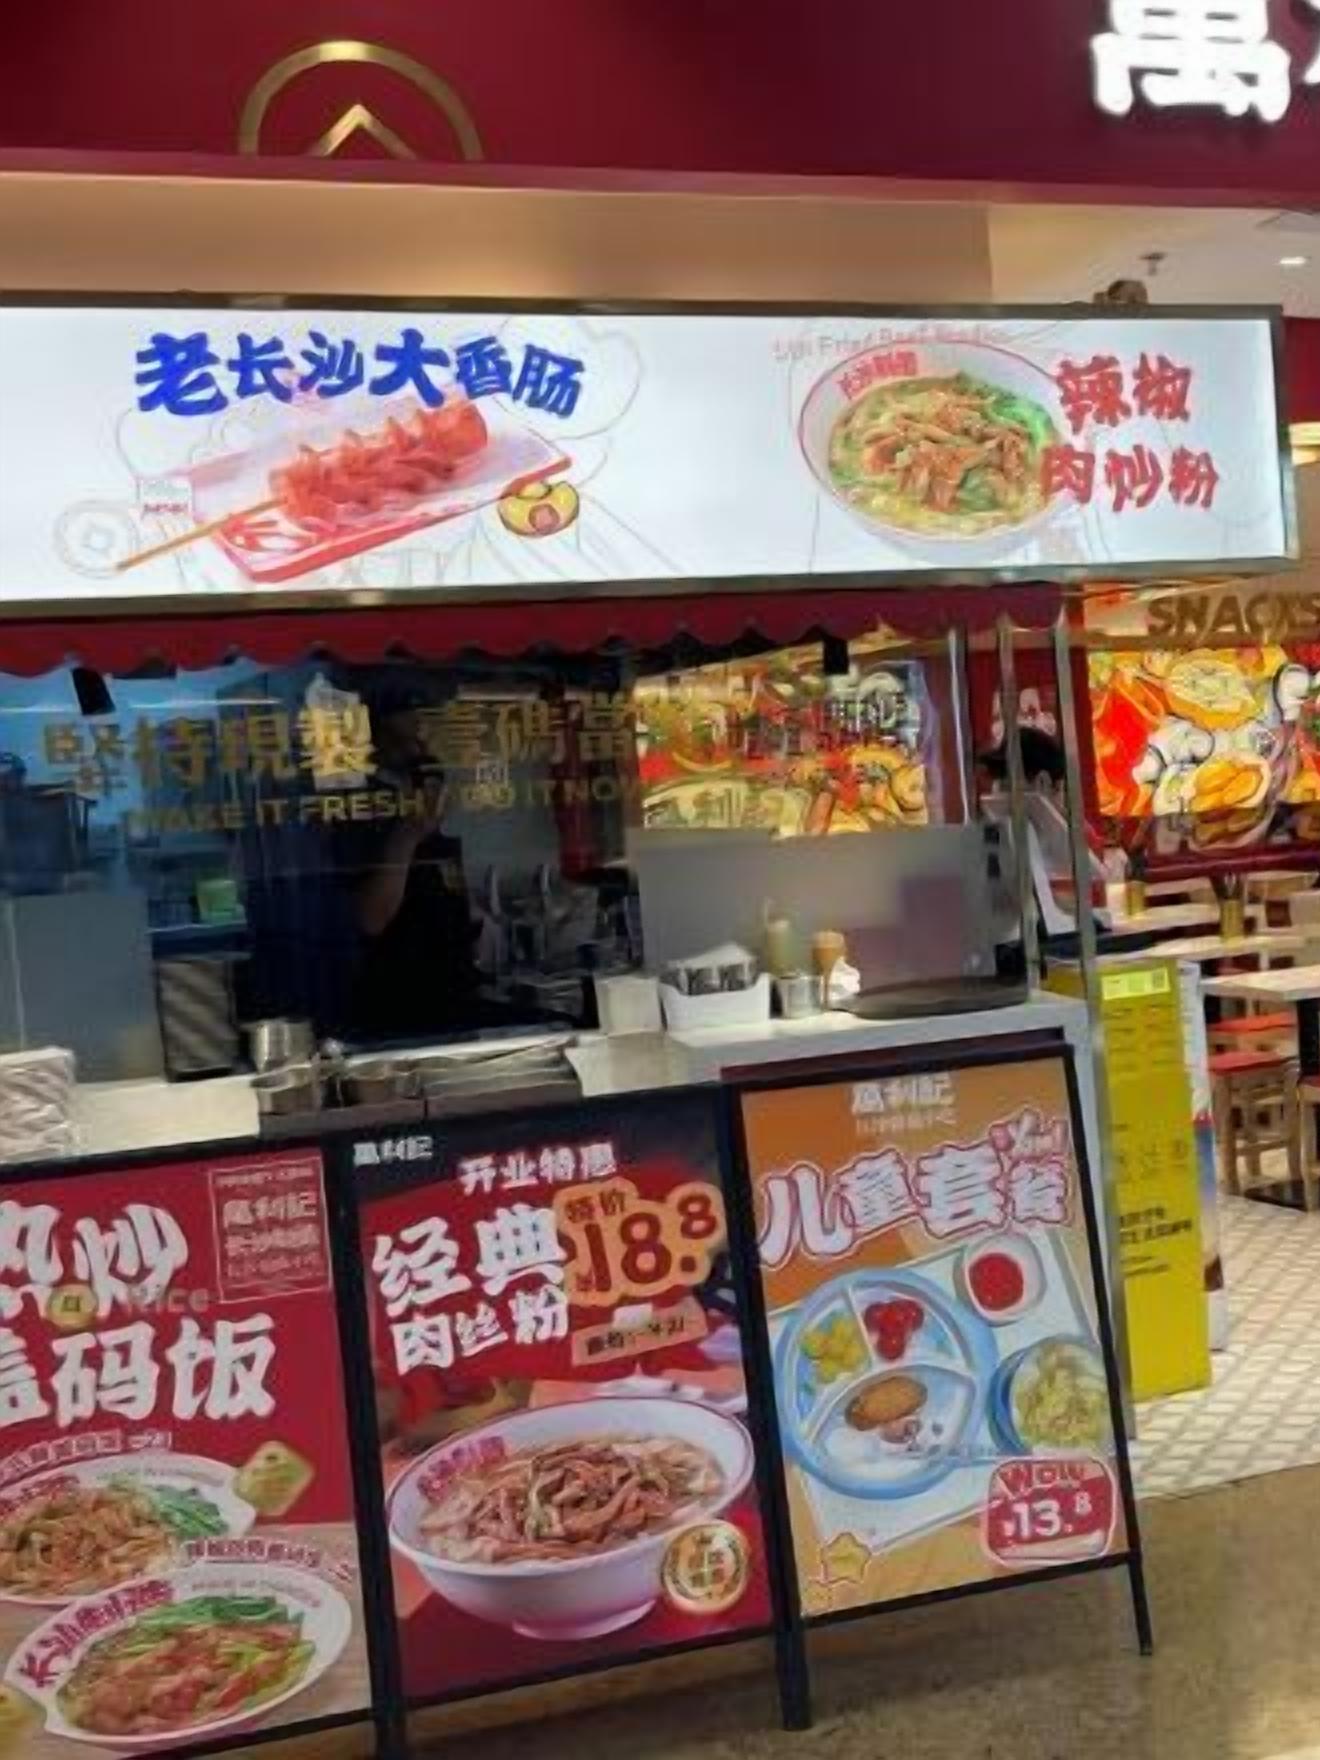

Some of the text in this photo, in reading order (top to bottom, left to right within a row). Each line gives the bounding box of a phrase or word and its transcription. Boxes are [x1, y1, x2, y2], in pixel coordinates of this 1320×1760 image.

[134, 327, 587, 421] 老长沙大香肠
[1055, 352, 1193, 436] 辣椒
[1040, 442, 1221, 514] 肉炒粉
[458, 1141, 617, 1195] 开业特惠
[757, 1106, 1071, 1267] 儿童套餐
[372, 1202, 568, 1317] 经典
